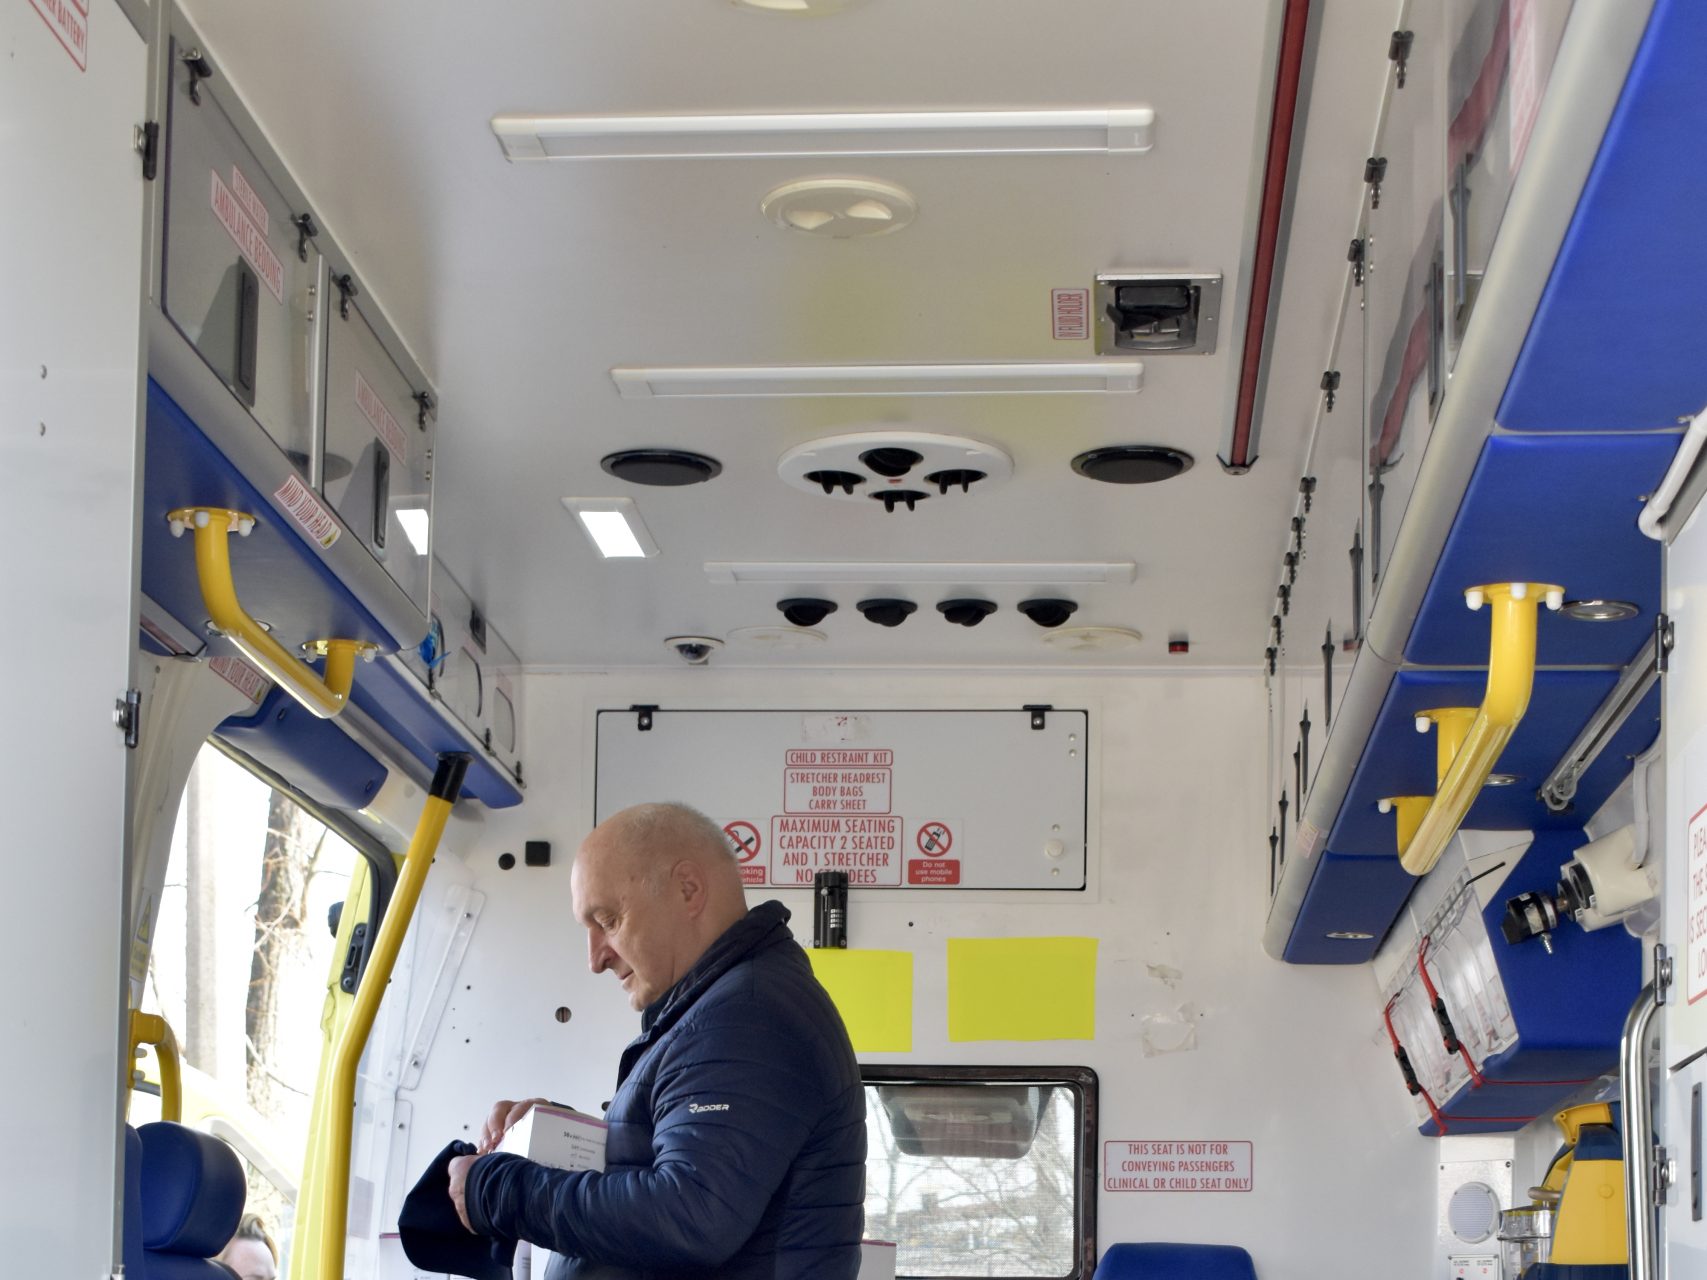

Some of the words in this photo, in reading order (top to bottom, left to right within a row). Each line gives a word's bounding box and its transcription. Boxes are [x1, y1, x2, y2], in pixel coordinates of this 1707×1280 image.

[215, 180, 254, 258] AMBULANCE
[255, 235, 280, 294] BEDDING
[278, 478, 304, 508] MIND
[297, 491, 319, 525] YOUR
[311, 511, 332, 540] HEAD
[790, 752, 816, 764] CHILD
[821, 752, 869, 764] RESTRAINT
[873, 752, 888, 764] KIT
[790, 772, 838, 784] STRETCHER
[841, 772, 886, 784] HEADREST
[812, 786, 837, 797] BODY
[840, 786, 864, 797] BAGS
[809, 799, 838, 810] CARRY
[840, 799, 867, 810] SHEET
[779, 819, 841, 833] MAXIMUM
[845, 819, 895, 834] SEATING
[779, 835, 837, 850] CAPACITY
[840, 835, 847, 850] 2
[851, 835, 895, 850] SEATED
[783, 852, 808, 866] AND
[814, 852, 818, 866] 1
[824, 852, 889, 867] STRETCHER
[796, 869, 813, 883] NO
[1128, 1143, 1149, 1155] THIS
[1151, 1143, 1173, 1155] SEAT
[1176, 1143, 1185, 1155] IS
[1188, 1143, 1207, 1155] NOT
[1210, 1143, 1228, 1155] FOR
[1121, 1160, 1175, 1172] CONVEYING
[1178, 1160, 1235, 1172] PASSENGERS
[1107, 1178, 1150, 1189] CLINICAL
[1153, 1178, 1166, 1189] OR
[1169, 1178, 1197, 1189] CHILD
[1200, 1178, 1222, 1189] SEAT
[1225, 1178, 1250, 1189] ONLY
